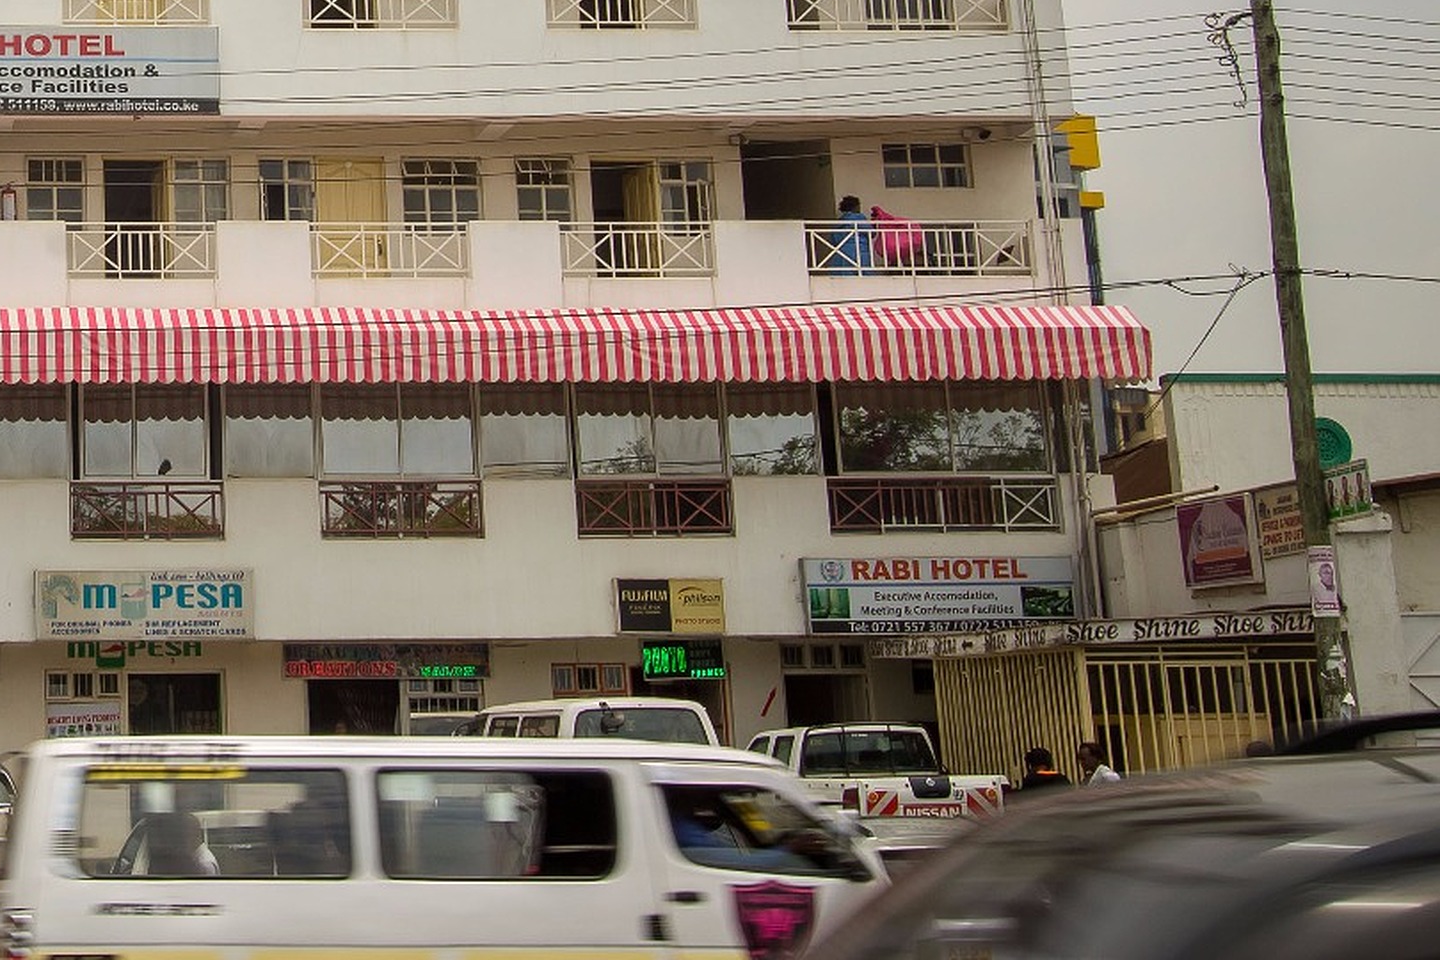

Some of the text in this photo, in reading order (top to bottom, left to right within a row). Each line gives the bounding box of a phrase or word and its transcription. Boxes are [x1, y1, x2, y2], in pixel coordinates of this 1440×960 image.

[143, 64, 160, 78] &
[31, 79, 129, 94] Facilities
[63, 99, 199, 112] www.rabihotel.co.ke
[851, 558, 1028, 581] RABI HOTEL
[621, 589, 668, 602] FUJIFILM
[874, 590, 999, 602] Executive Accomodation,
[861, 603, 1015, 617] Meeting & Conference Facilities
[871, 621, 901, 633] 0721
[904, 621, 926, 633] 557
[929, 621, 950, 632] 367
[1065, 621, 1120, 645] Shoe
[1132, 617, 1202, 641] Shine
[1213, 615, 1265, 637] Shoe
[643, 646, 687, 675] PHOTO
[906, 807, 960, 817] NISSAN
